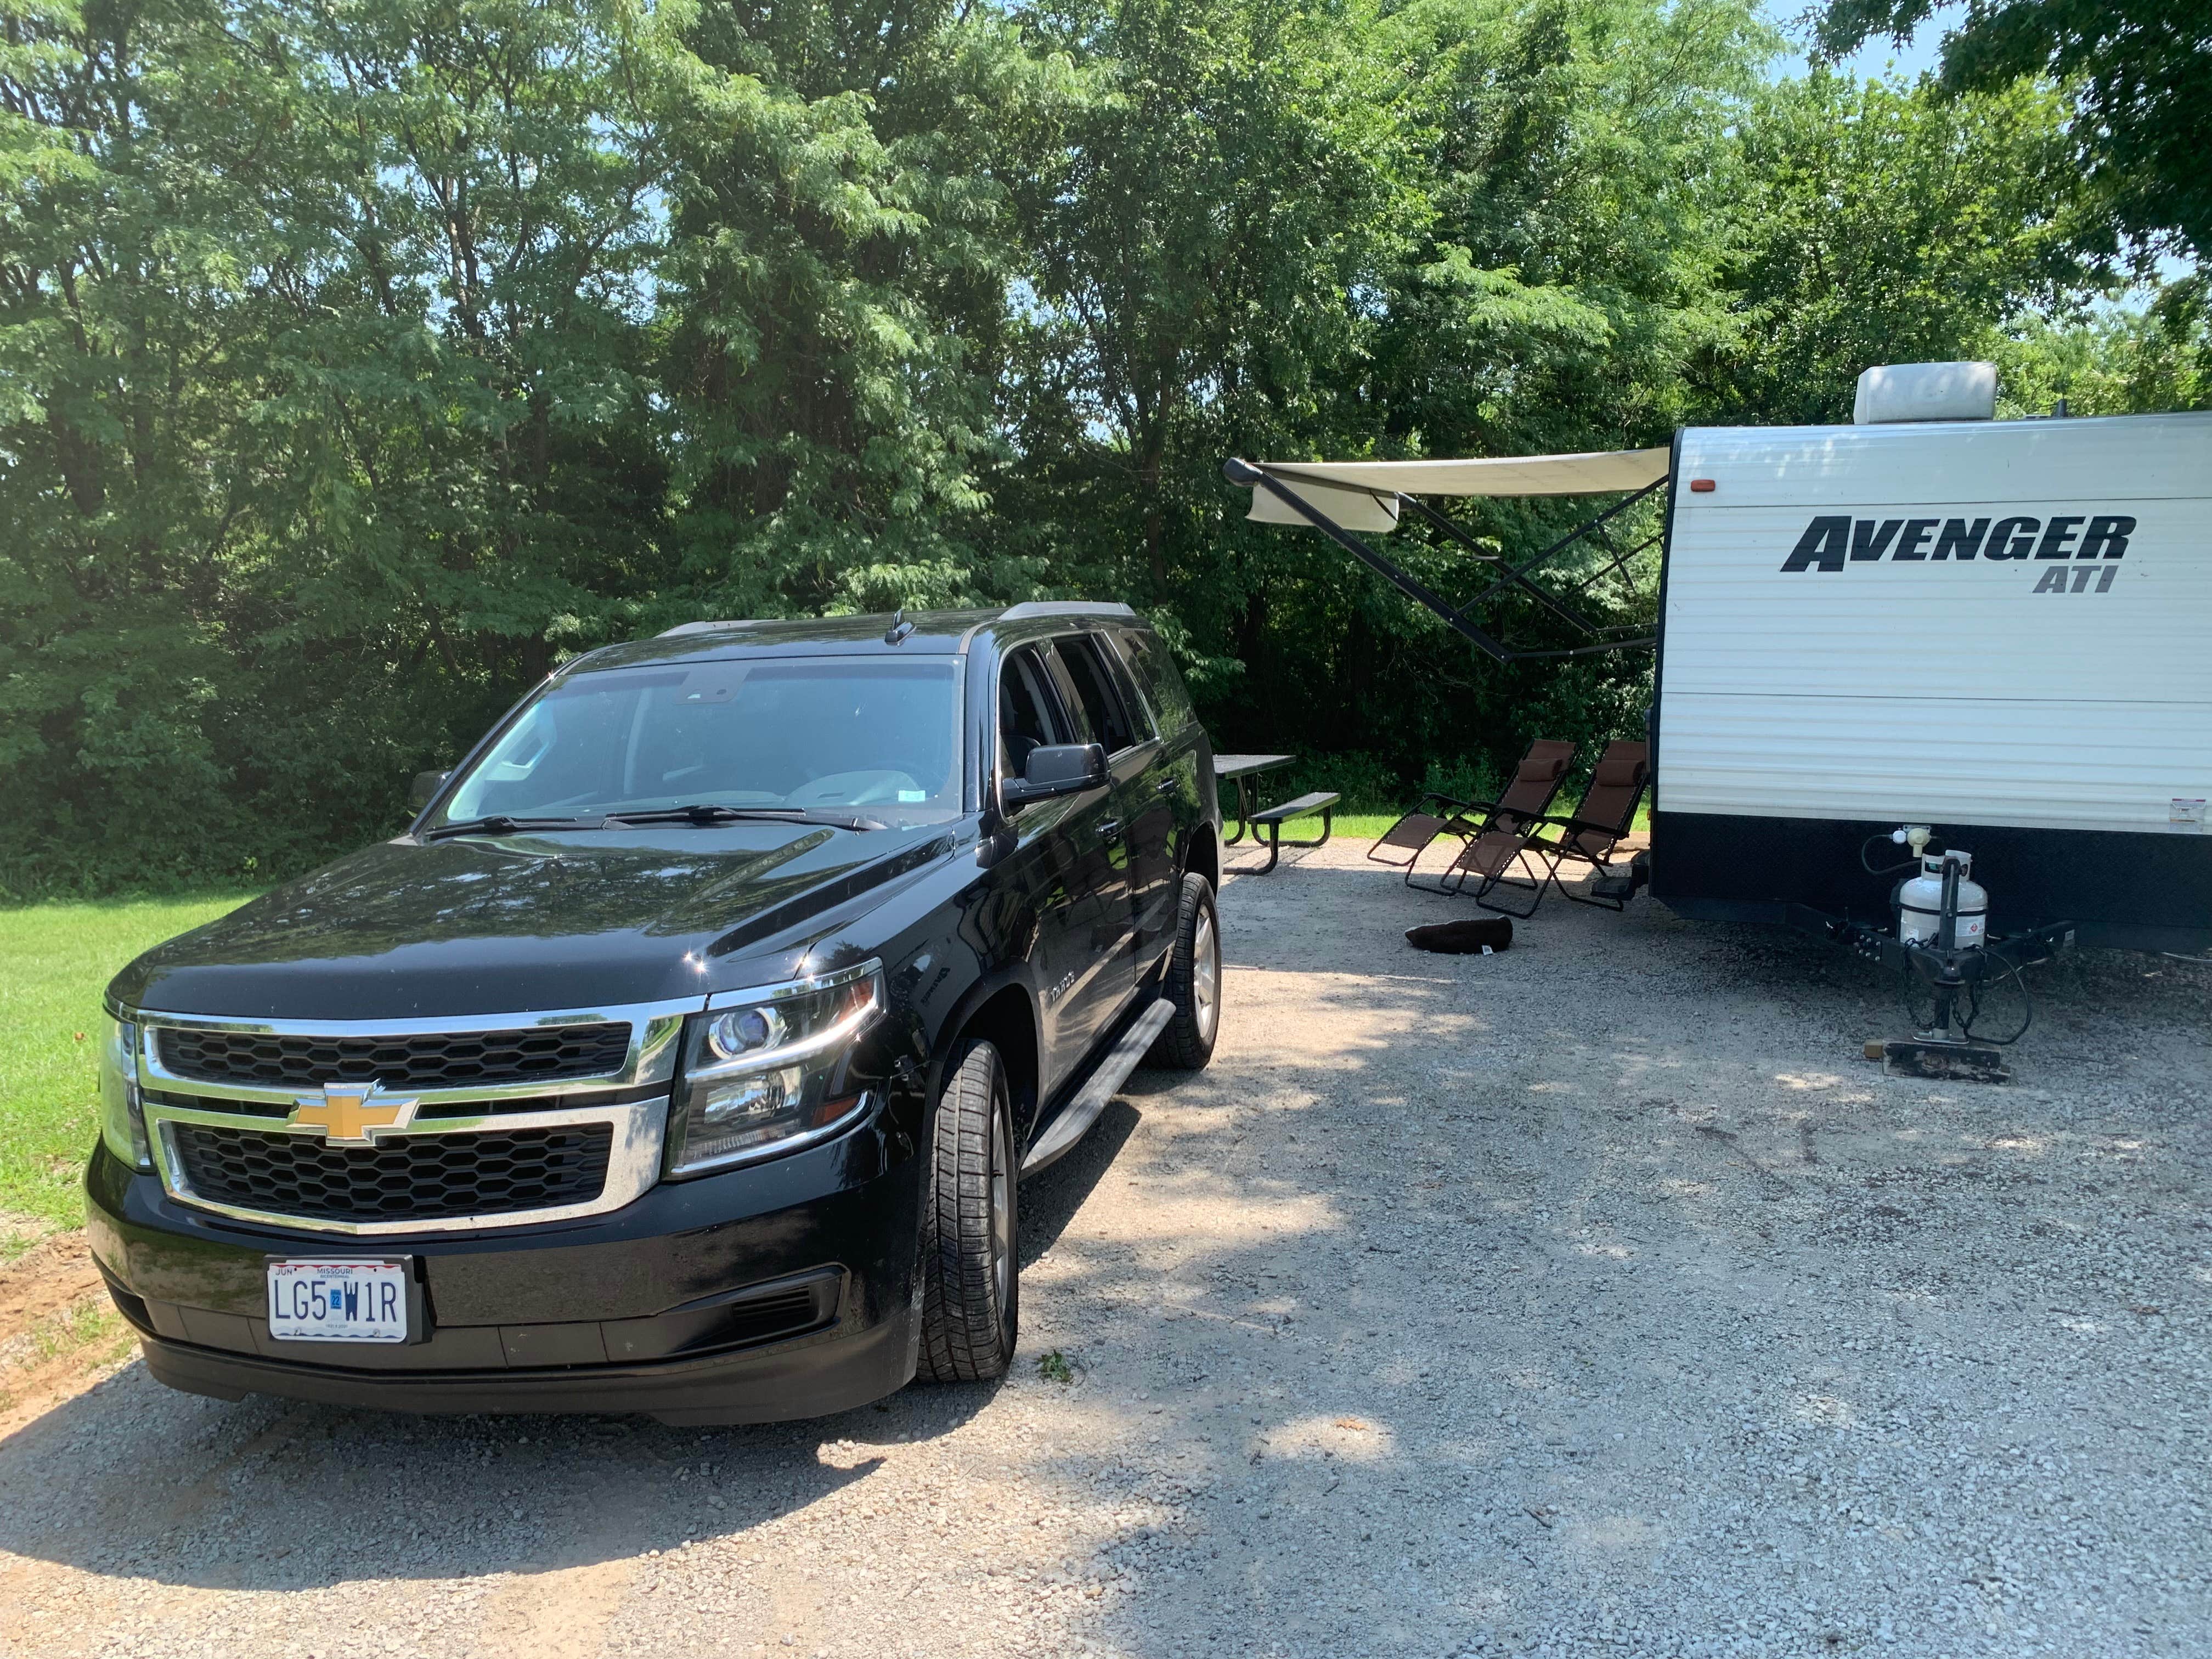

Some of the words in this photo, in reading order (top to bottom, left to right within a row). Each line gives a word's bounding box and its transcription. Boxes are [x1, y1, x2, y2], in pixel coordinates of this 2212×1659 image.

[1780, 516, 2137, 572] AVENGER
[2032, 565, 2119, 593] ATI
[275, 1280, 326, 1321] LG5
[344, 1281, 397, 1322] W1R
[332, 1295, 340, 1306] 22
